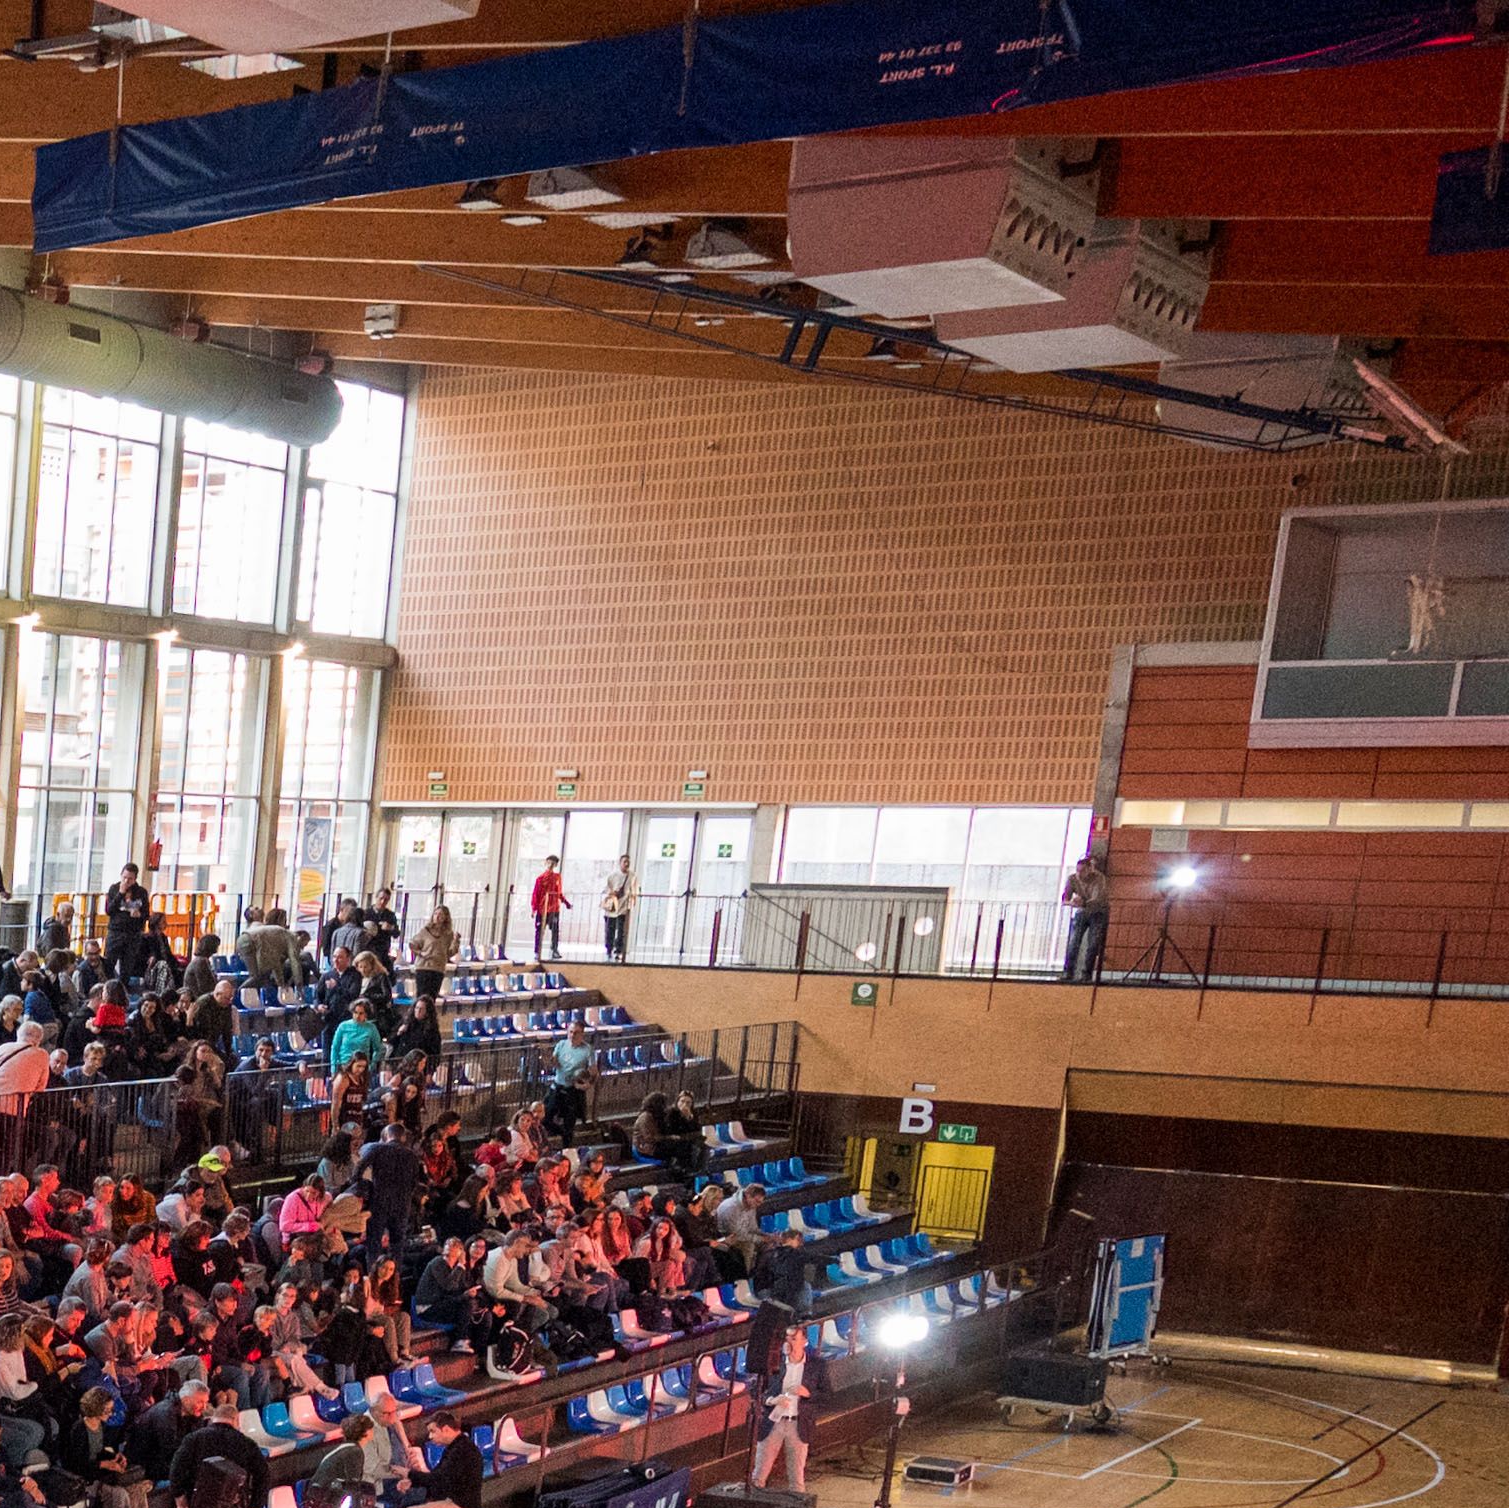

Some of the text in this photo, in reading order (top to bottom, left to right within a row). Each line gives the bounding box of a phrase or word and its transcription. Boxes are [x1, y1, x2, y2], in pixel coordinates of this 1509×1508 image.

[996, 36, 1045, 54] SPORT
[879, 66, 926, 84] SPORT
[409, 123, 448, 138] SPORT
[899, 1098, 934, 1135] B
